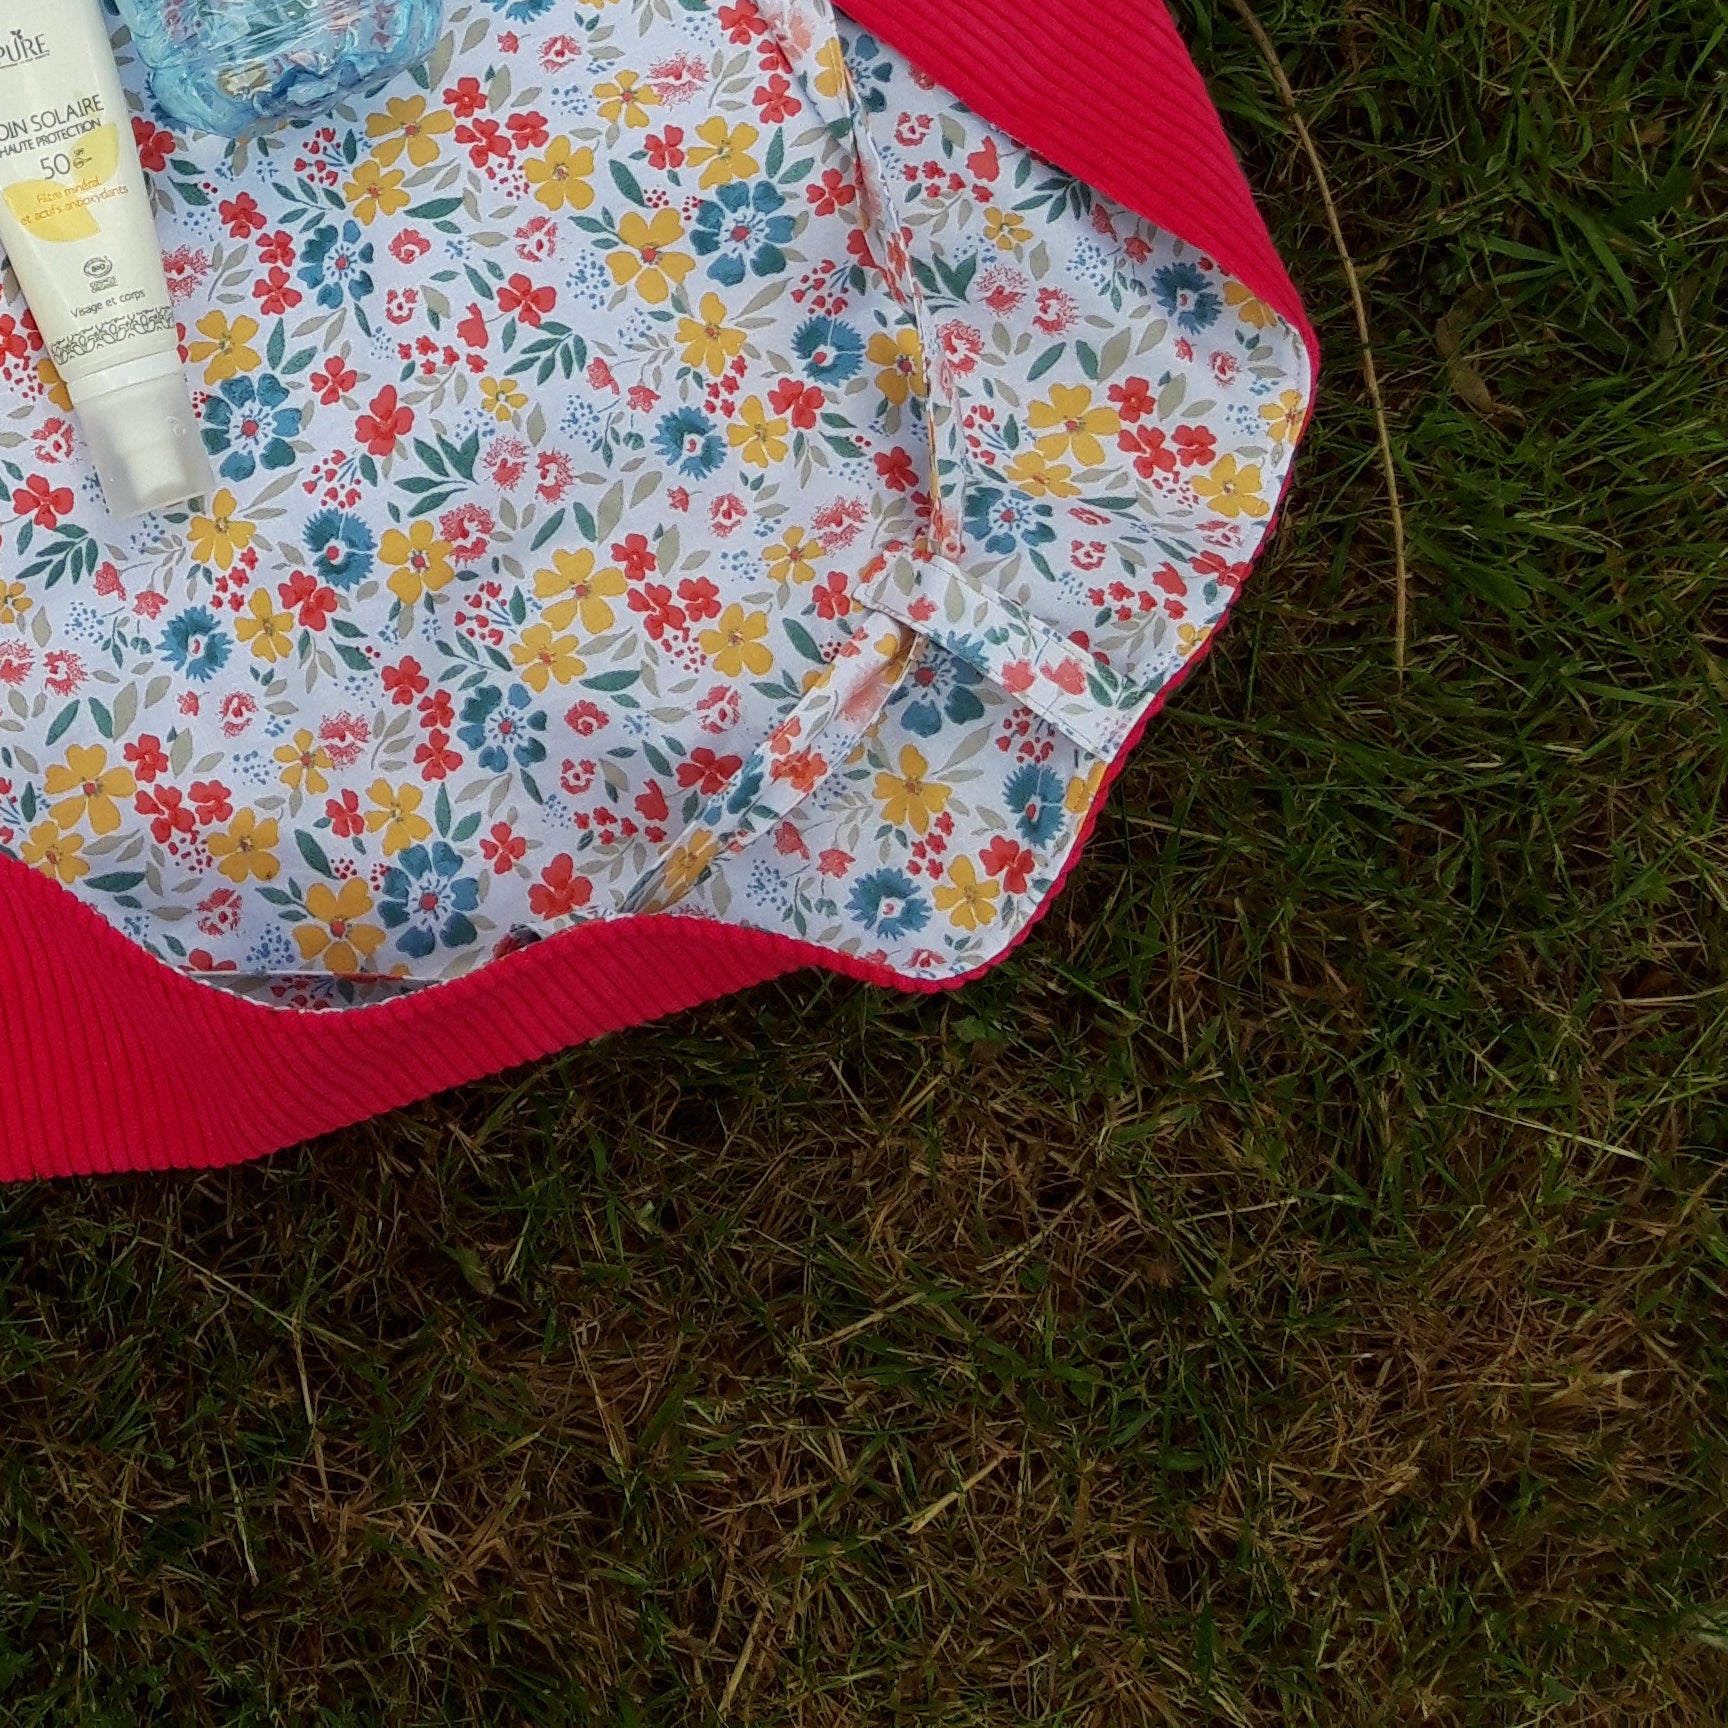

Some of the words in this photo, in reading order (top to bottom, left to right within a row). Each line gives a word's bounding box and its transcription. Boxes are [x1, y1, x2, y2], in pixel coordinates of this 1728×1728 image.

[31, 94, 105, 133] SOLAIRE
[36, 117, 102, 149] PROTECTION
[40, 153, 71, 180] 50
[21, 215, 32, 226] et
[70, 301, 104, 319] Visage
[105, 296, 118, 308] et
[119, 288, 146, 303] corps
